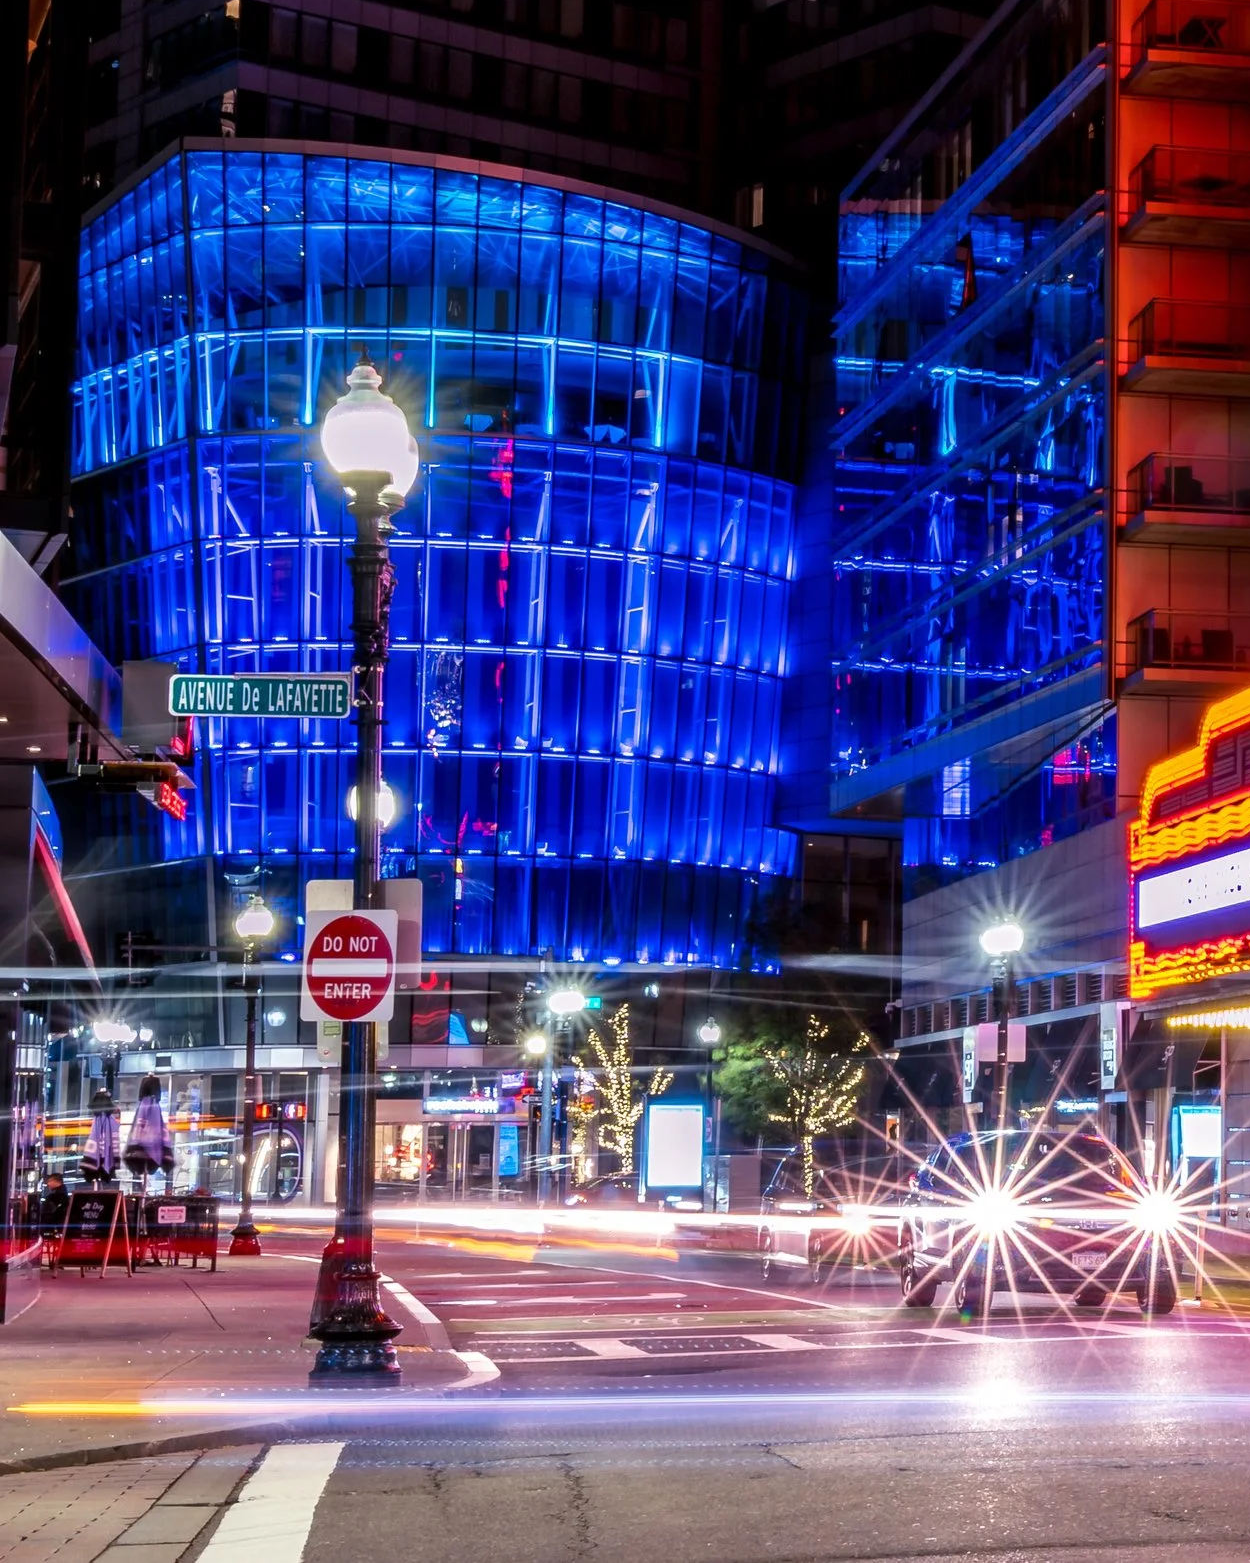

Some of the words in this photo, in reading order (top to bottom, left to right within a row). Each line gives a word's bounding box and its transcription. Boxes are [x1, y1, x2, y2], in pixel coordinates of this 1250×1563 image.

[178, 681, 234, 711] AVENUE
[242, 682, 260, 711] De
[268, 683, 343, 713] LAFAYETTE
[323, 936, 343, 952] DO
[349, 936, 379, 952] NOT
[324, 983, 371, 999] ENTER
